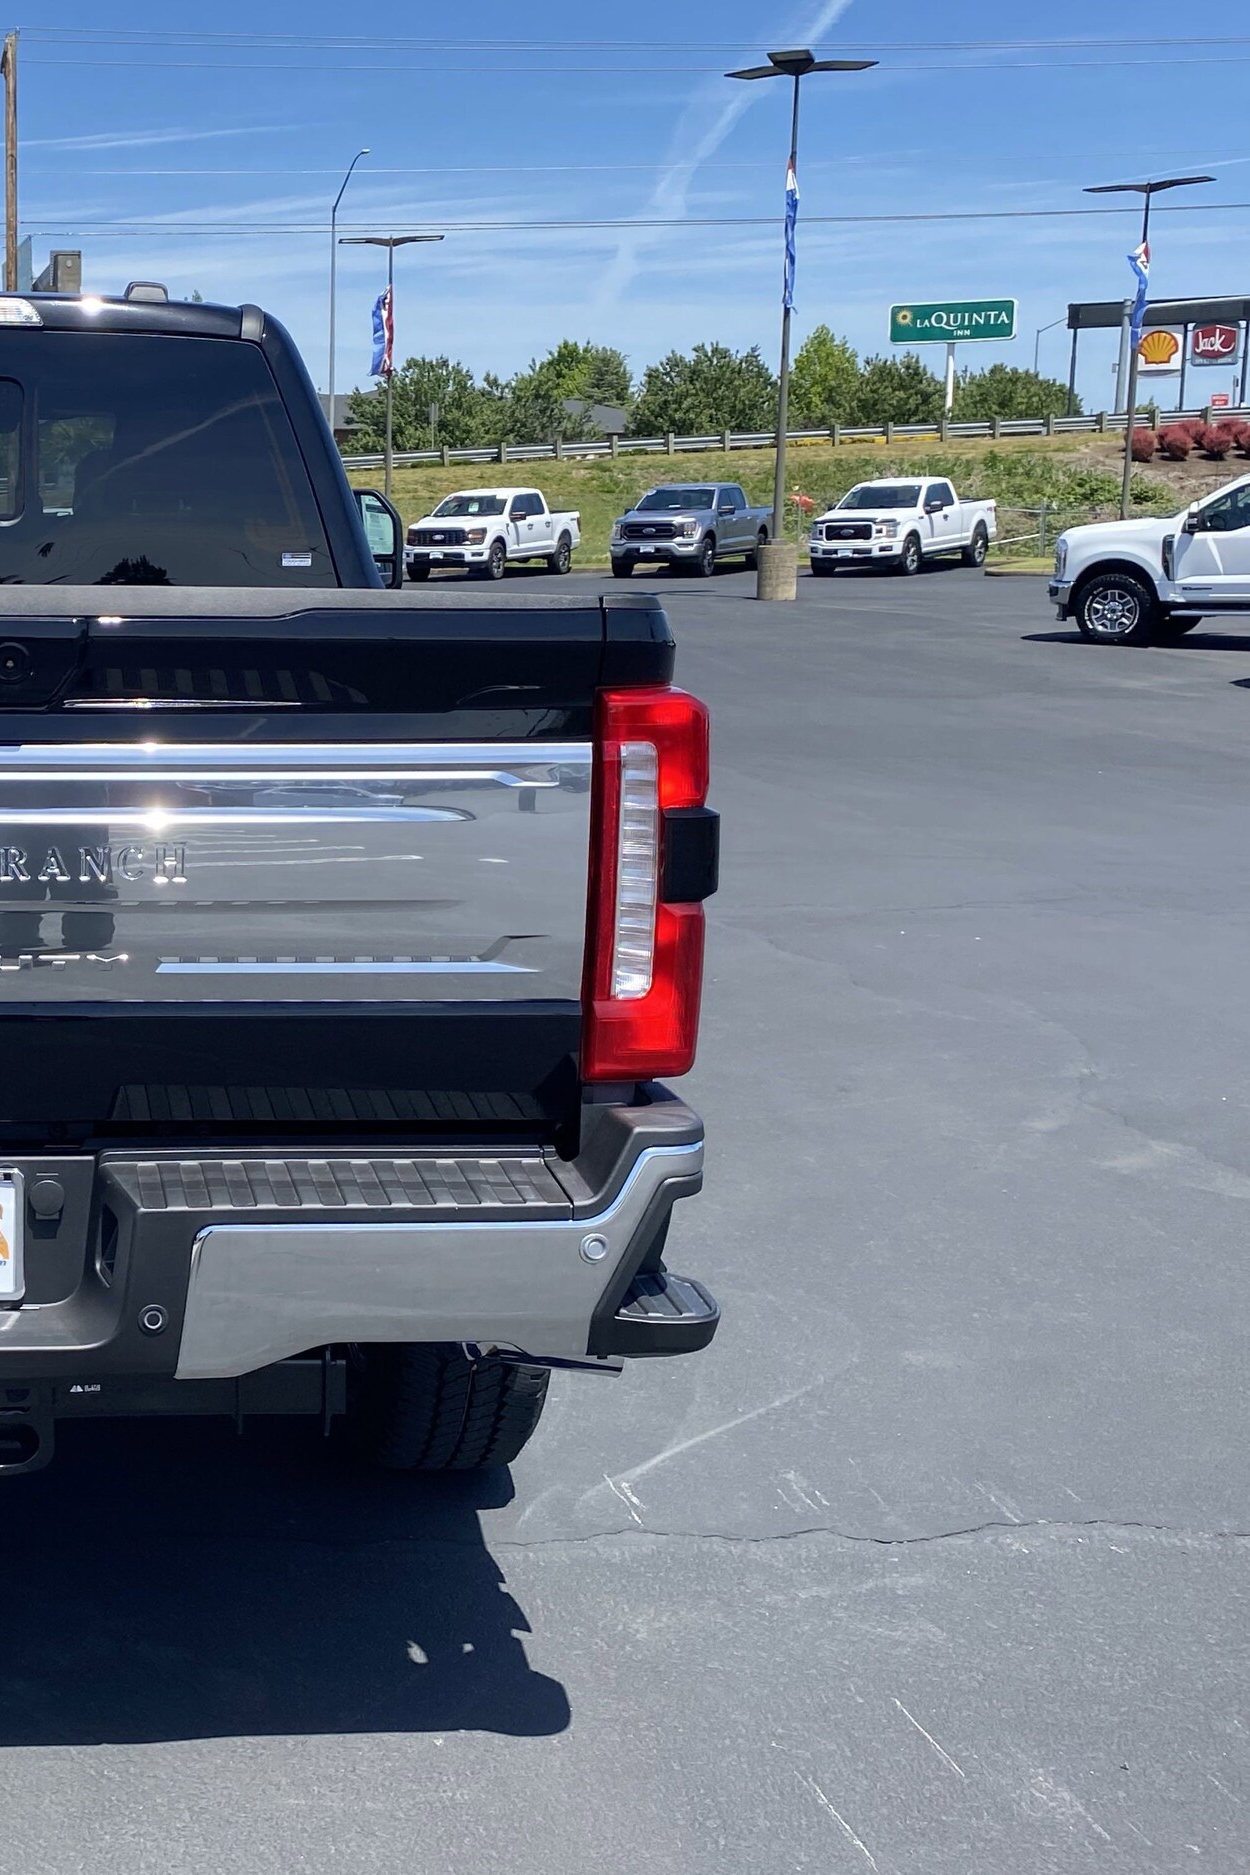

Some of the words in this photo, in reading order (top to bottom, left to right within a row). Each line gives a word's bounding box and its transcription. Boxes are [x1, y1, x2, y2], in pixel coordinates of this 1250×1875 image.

[931, 311, 1010, 330] QUINTA
[1194, 328, 1236, 353] Jack
[0, 841, 187, 884] RANCH
